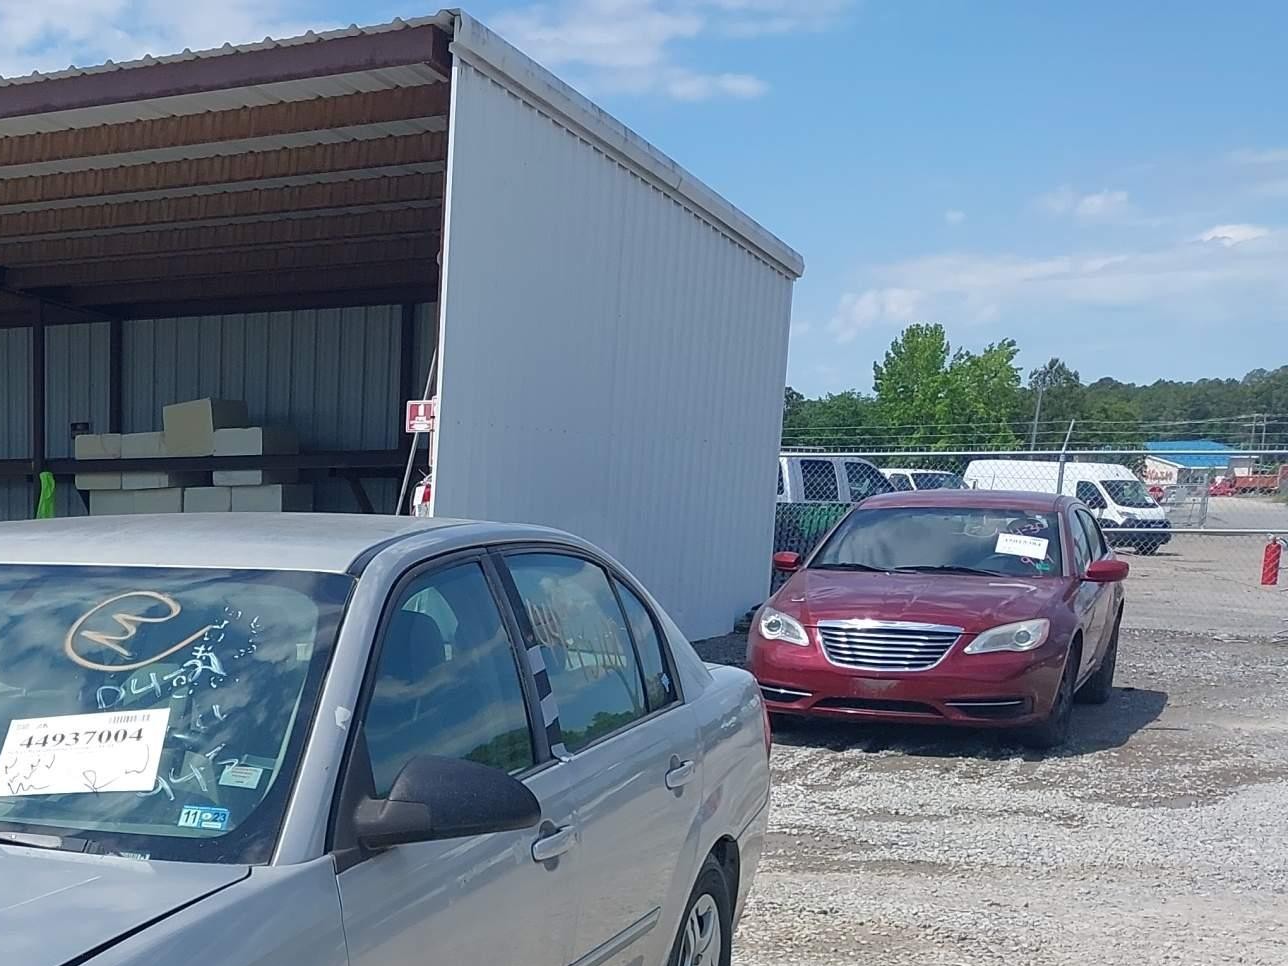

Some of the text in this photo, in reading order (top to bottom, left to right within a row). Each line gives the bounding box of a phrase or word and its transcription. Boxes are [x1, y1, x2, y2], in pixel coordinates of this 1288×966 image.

[19, 727, 144, 749] 44937004
[183, 810, 227, 824] 11 23
